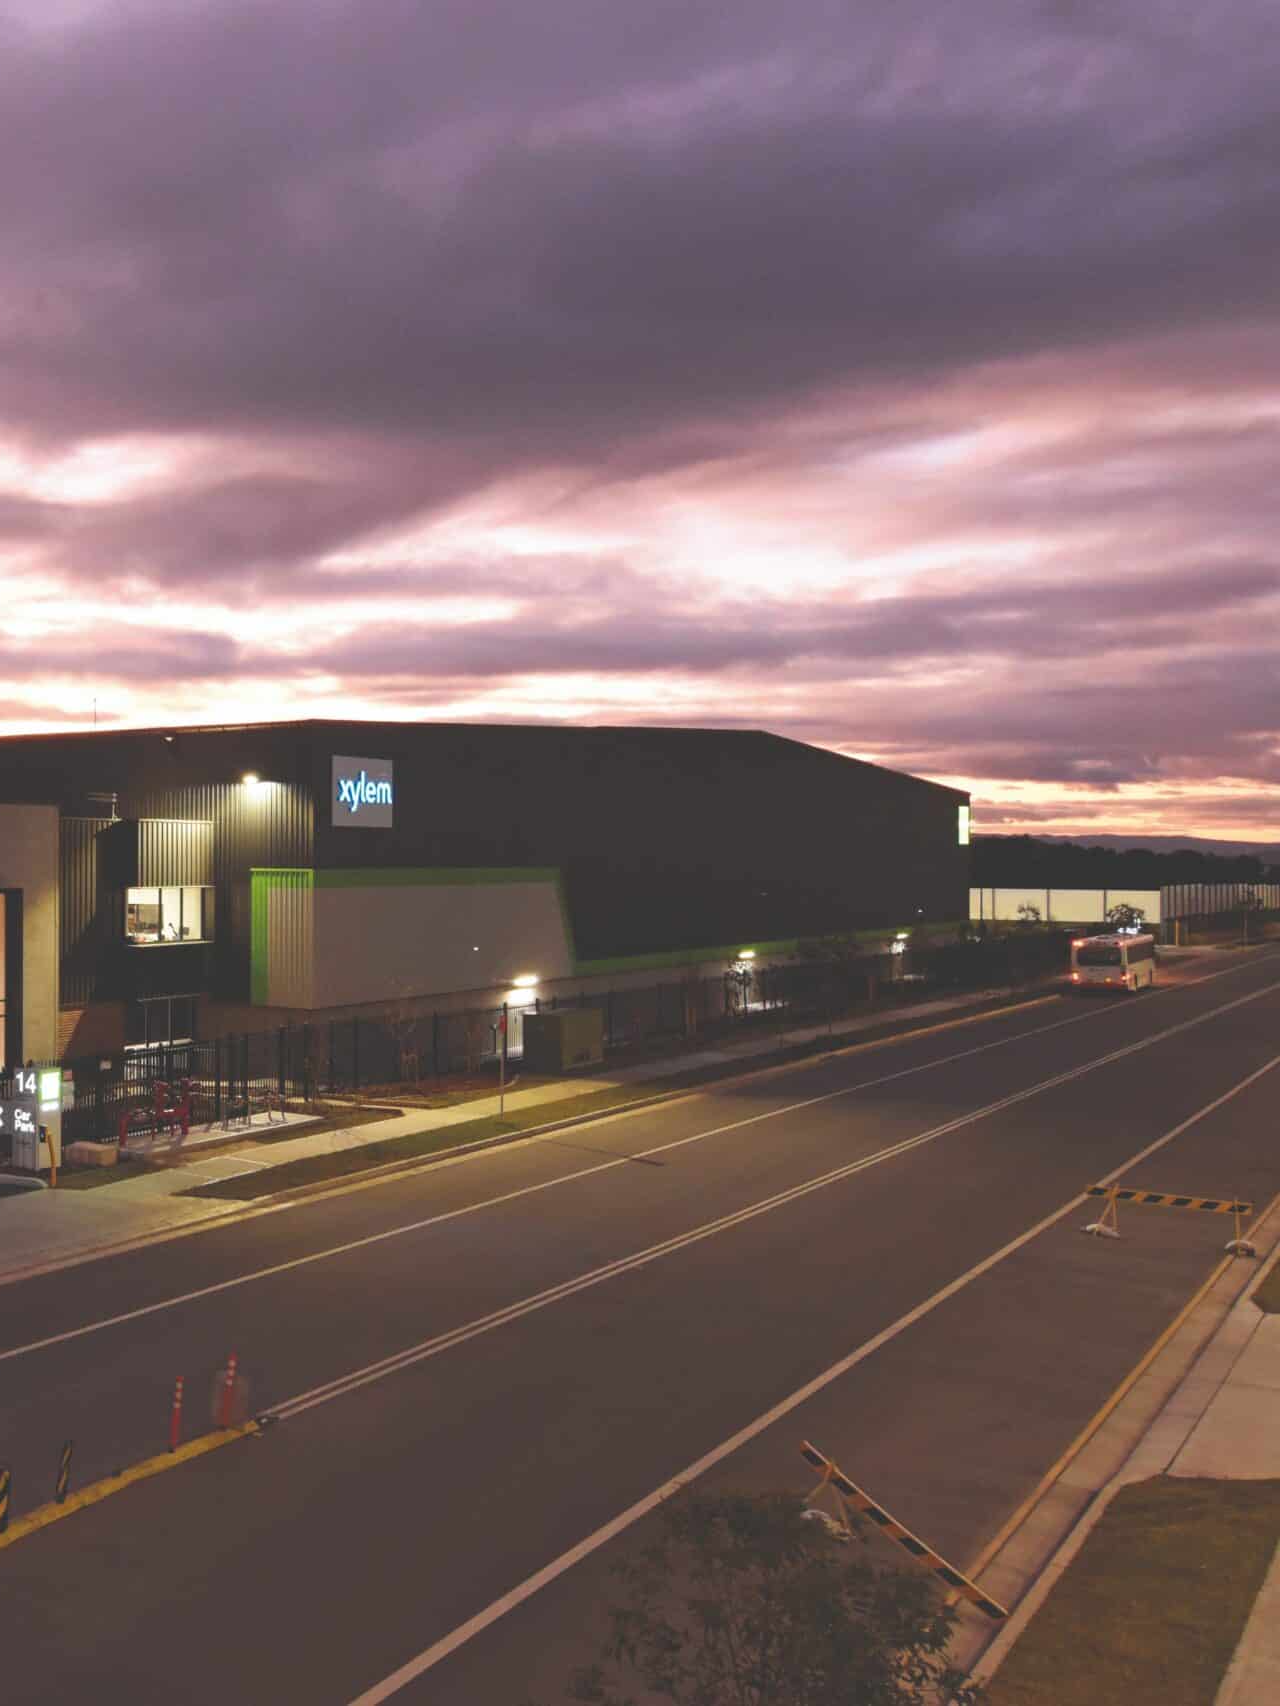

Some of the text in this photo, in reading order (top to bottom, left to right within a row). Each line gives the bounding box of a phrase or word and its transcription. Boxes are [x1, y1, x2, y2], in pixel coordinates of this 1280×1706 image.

[338, 769, 393, 812] xylem
[15, 1071, 37, 1094] 14
[14, 1109, 32, 1121] Car
[14, 1119, 35, 1132] Park
